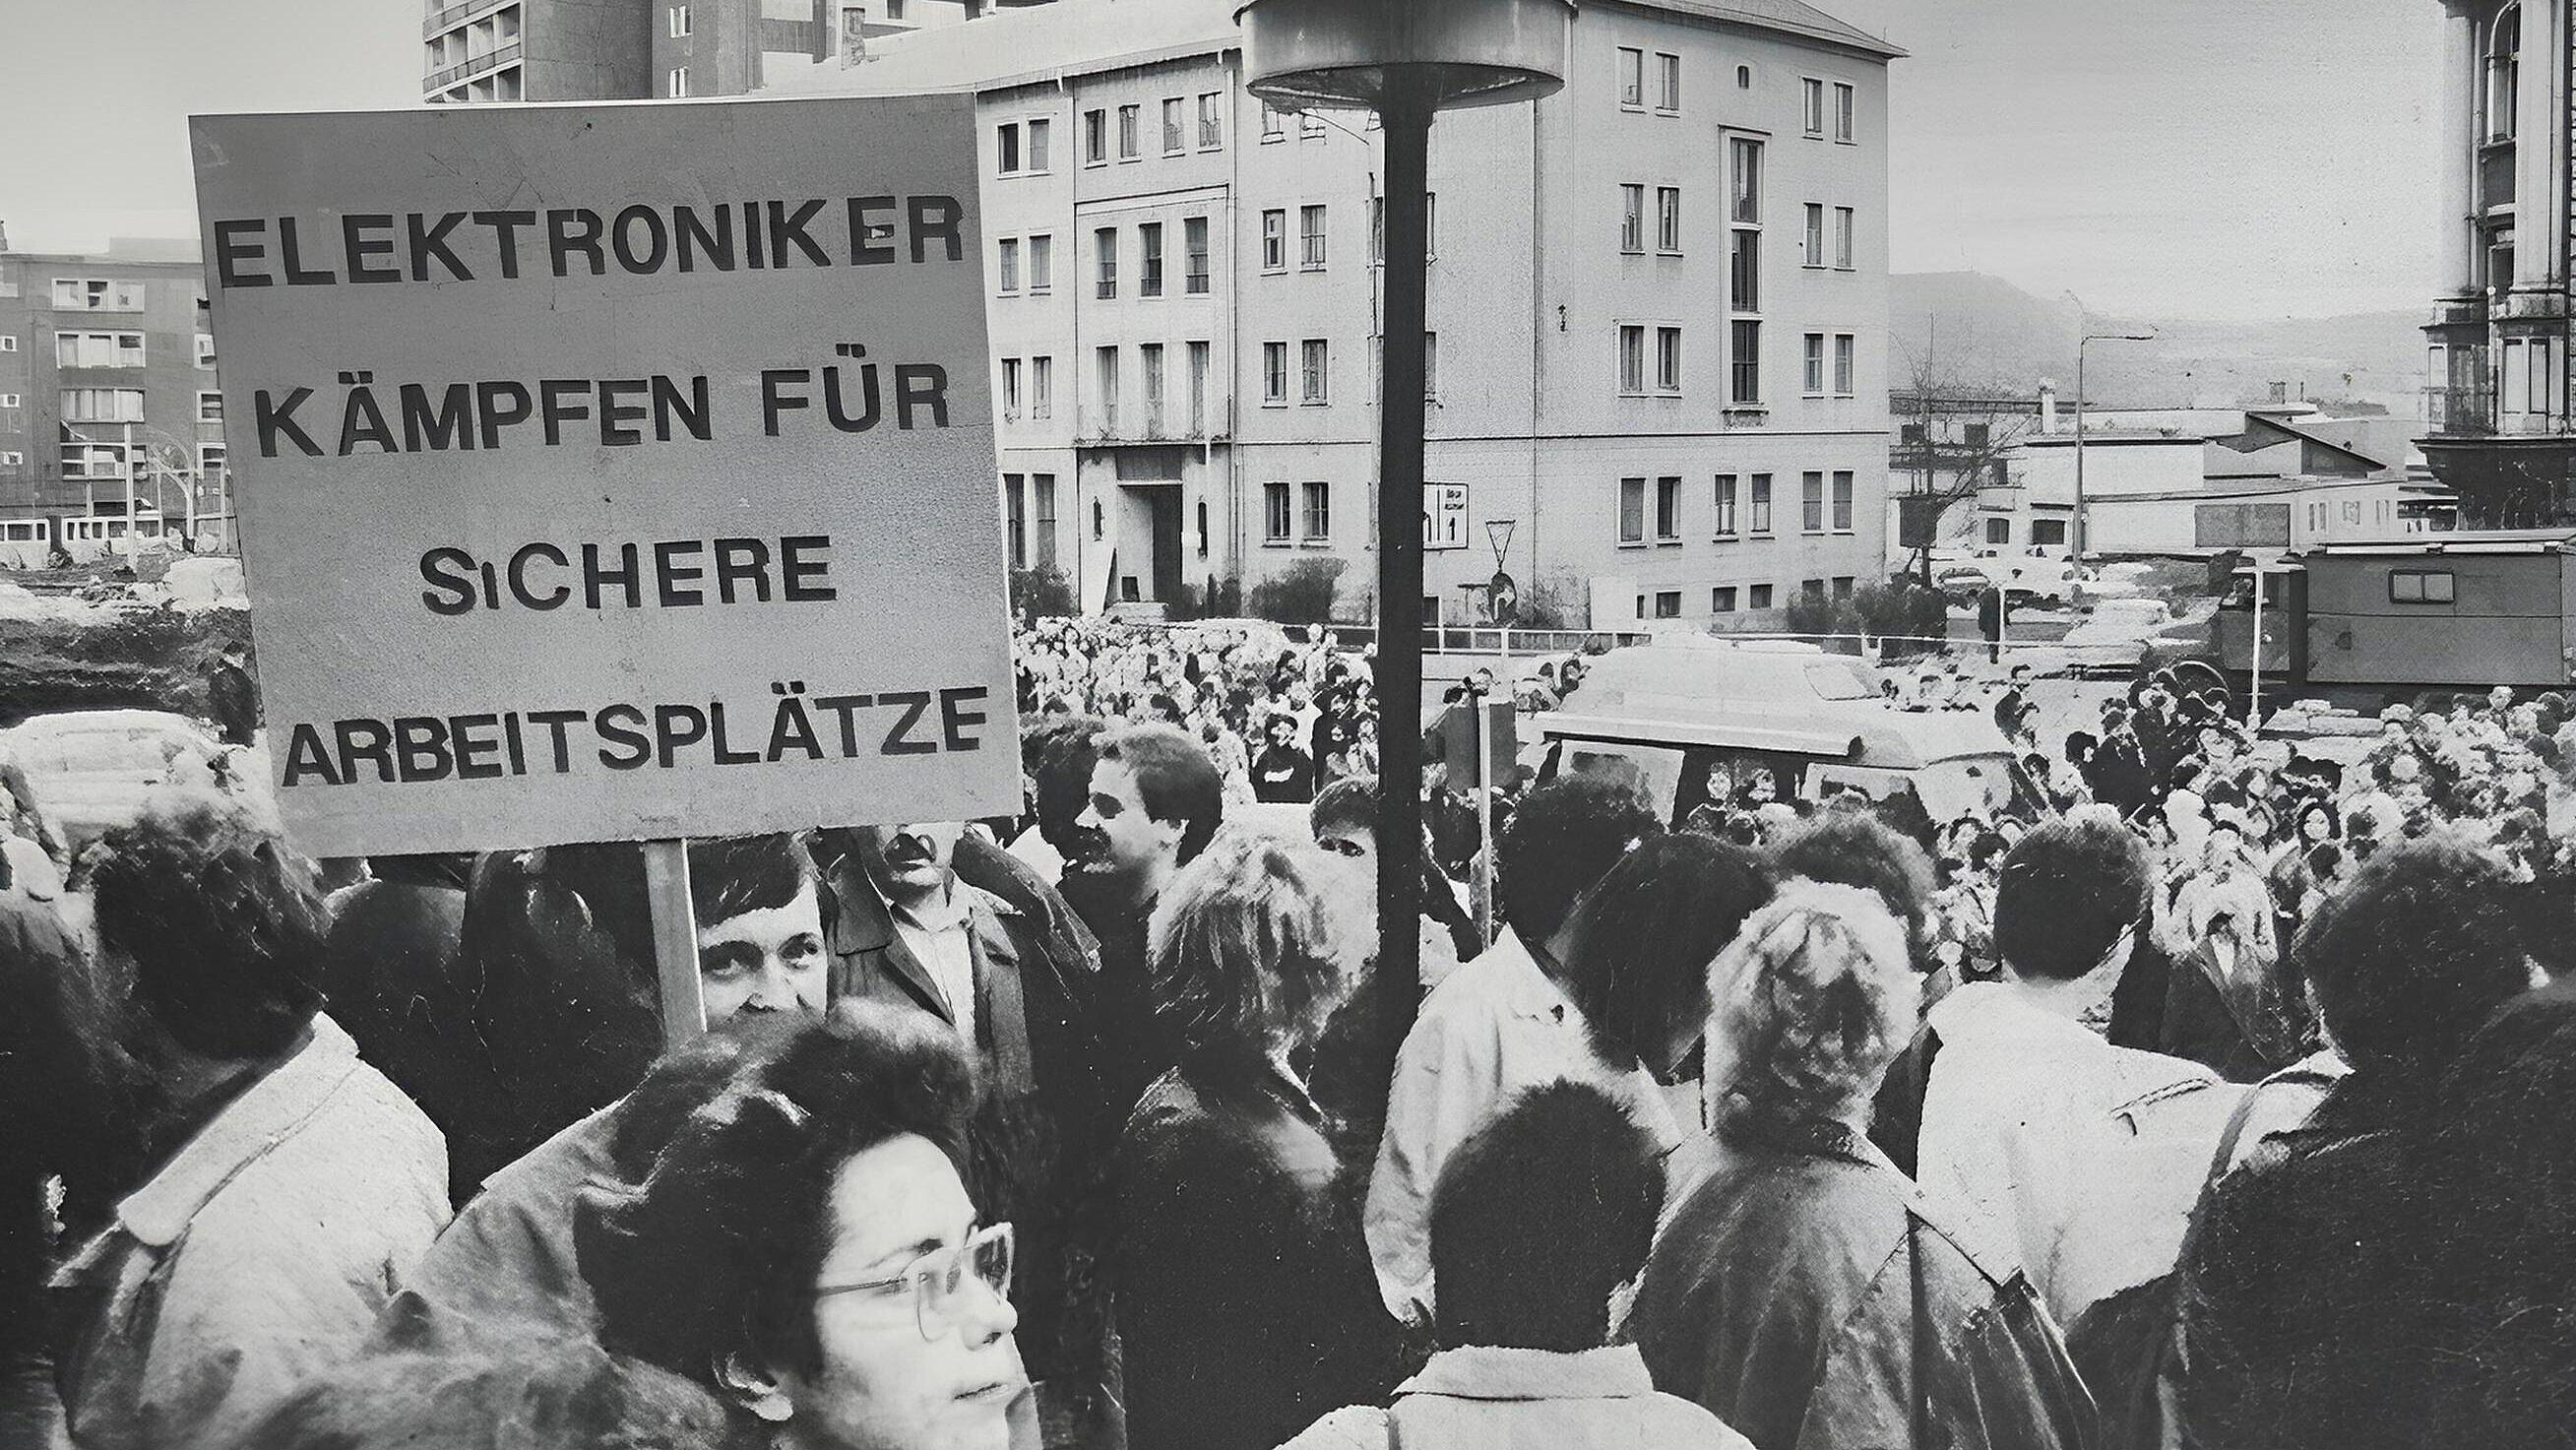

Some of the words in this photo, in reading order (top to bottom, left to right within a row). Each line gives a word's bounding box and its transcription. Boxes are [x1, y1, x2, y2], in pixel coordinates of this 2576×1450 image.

[214, 196, 965, 288] ELEKTRONIKER
[254, 370, 713, 458] KÄMPFEN
[761, 343, 950, 436] FÜR
[282, 681, 988, 788] ARBEITSPLÄTZE
